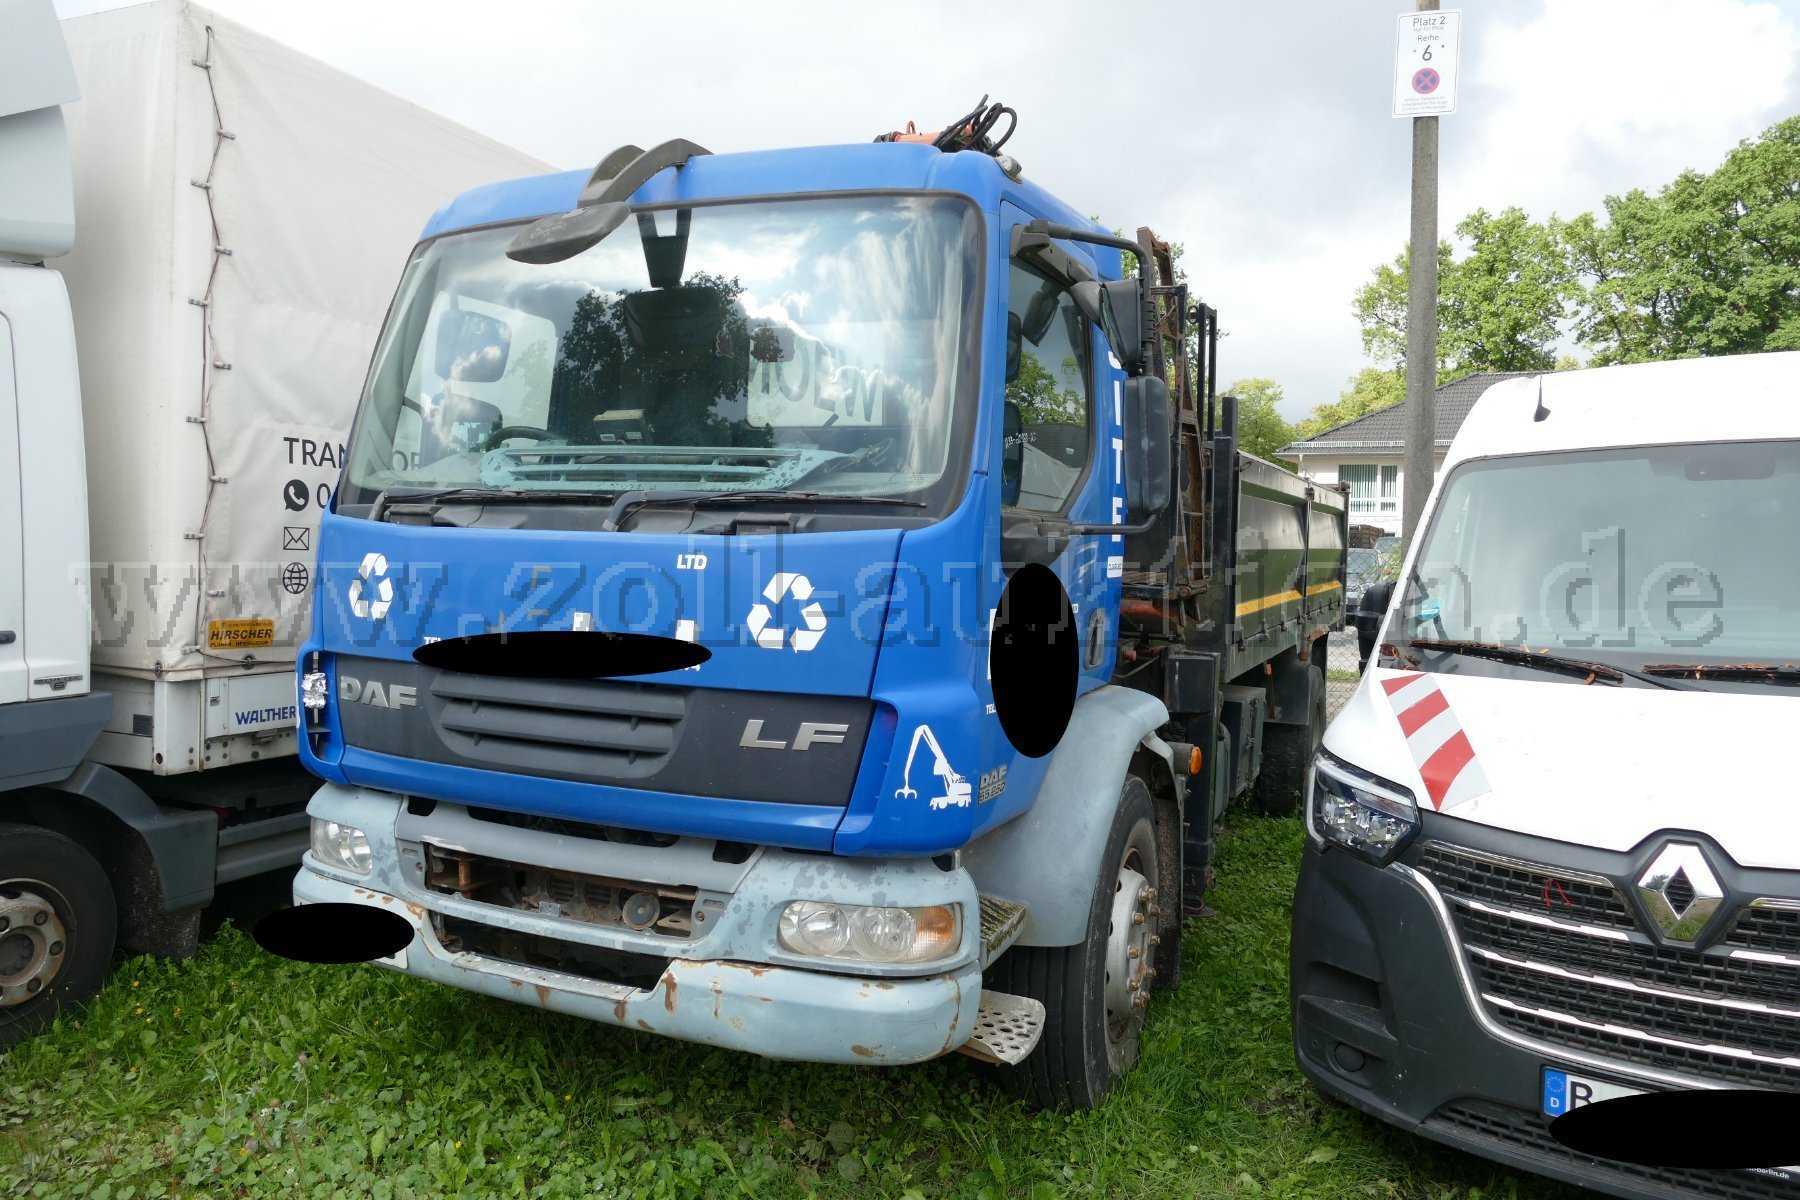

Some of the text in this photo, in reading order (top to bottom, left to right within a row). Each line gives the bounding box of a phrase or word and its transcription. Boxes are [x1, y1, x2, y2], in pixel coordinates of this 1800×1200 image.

[1412, 15, 1446, 28] Platz 2
[1417, 34, 1440, 43] Reihe
[1421, 44, 1433, 62] 6
[676, 553, 709, 572] LTD
[210, 629, 273, 641] HIRSCHER
[339, 675, 418, 710] DAF
[235, 705, 297, 725] WALTHER
[739, 719, 850, 751] LF
[979, 763, 1008, 786] DAF
[1550, 1097, 1560, 1108] D
